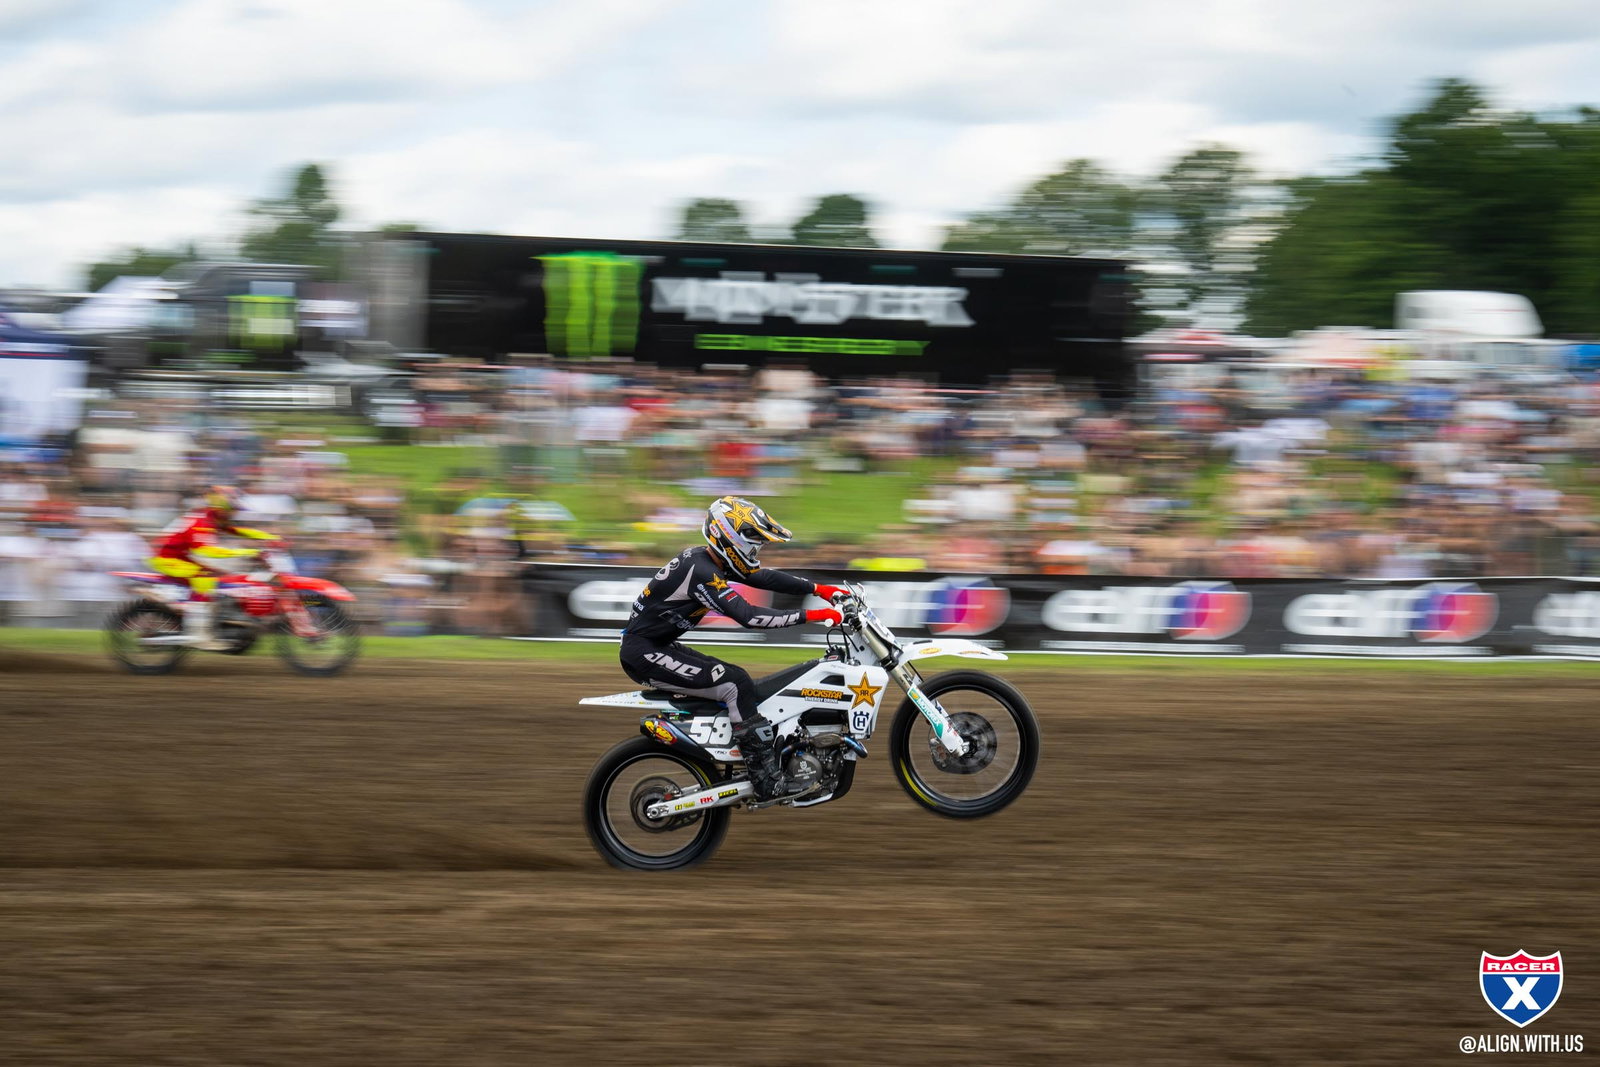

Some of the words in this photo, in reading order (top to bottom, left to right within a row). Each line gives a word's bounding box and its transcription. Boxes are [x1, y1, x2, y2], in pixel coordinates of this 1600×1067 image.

[801, 687, 842, 700] ROCKSTAR
[688, 716, 733, 745] 58
[700, 796, 714, 804] RK
